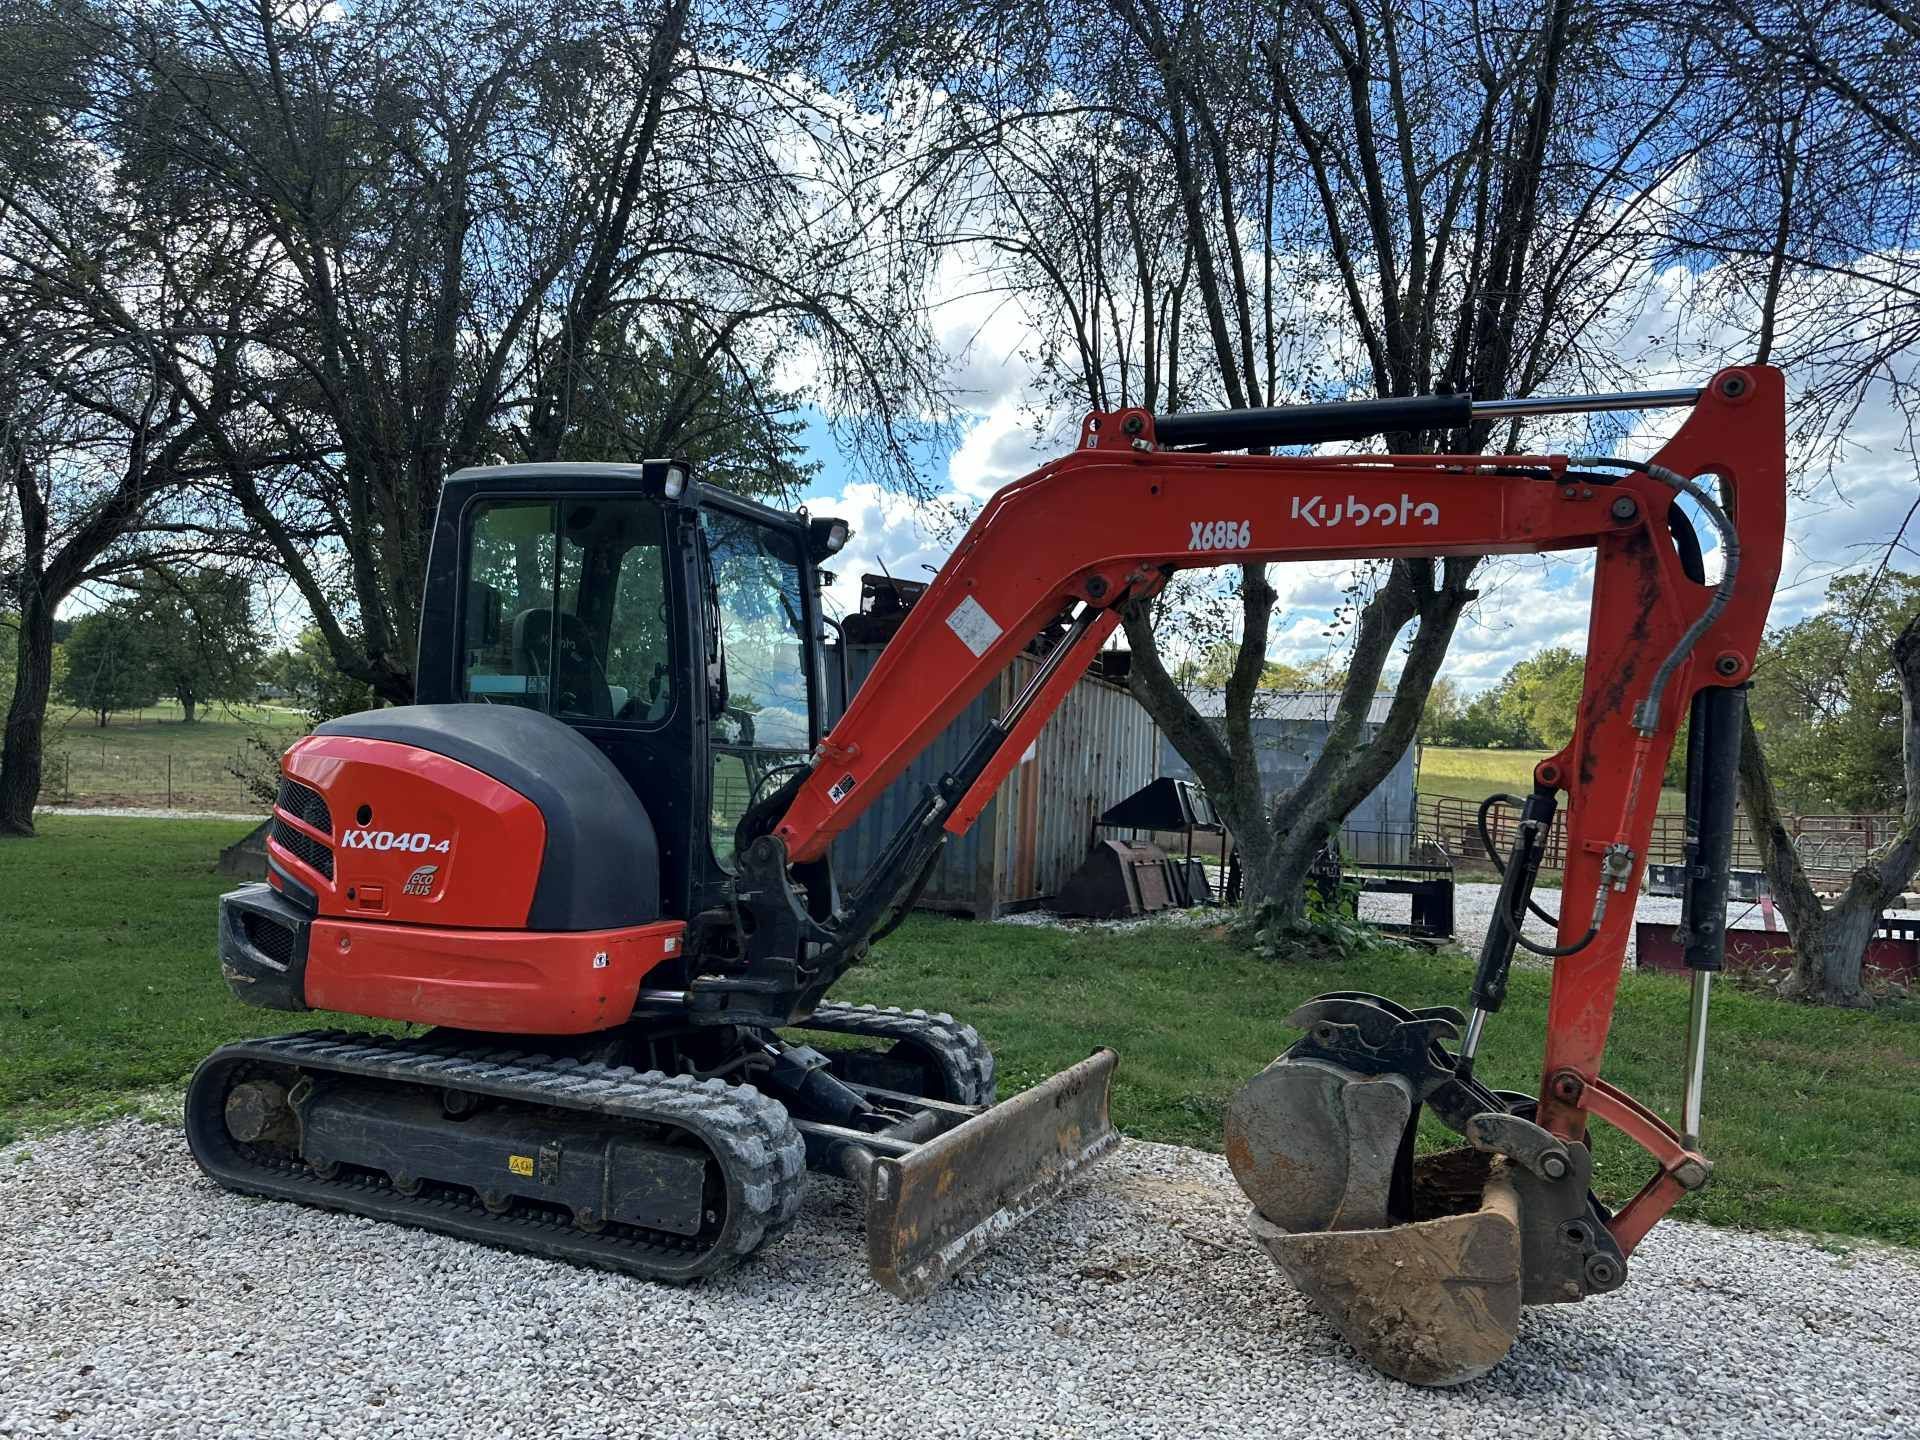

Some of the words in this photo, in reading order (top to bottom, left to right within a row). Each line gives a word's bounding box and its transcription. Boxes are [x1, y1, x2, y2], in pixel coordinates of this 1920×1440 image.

[1291, 494, 1440, 527] Kubota
[1189, 520, 1251, 551] X6856
[341, 829, 450, 853] KX040-4
[402, 884, 431, 896] PLUS
[411, 873, 434, 885] eco
